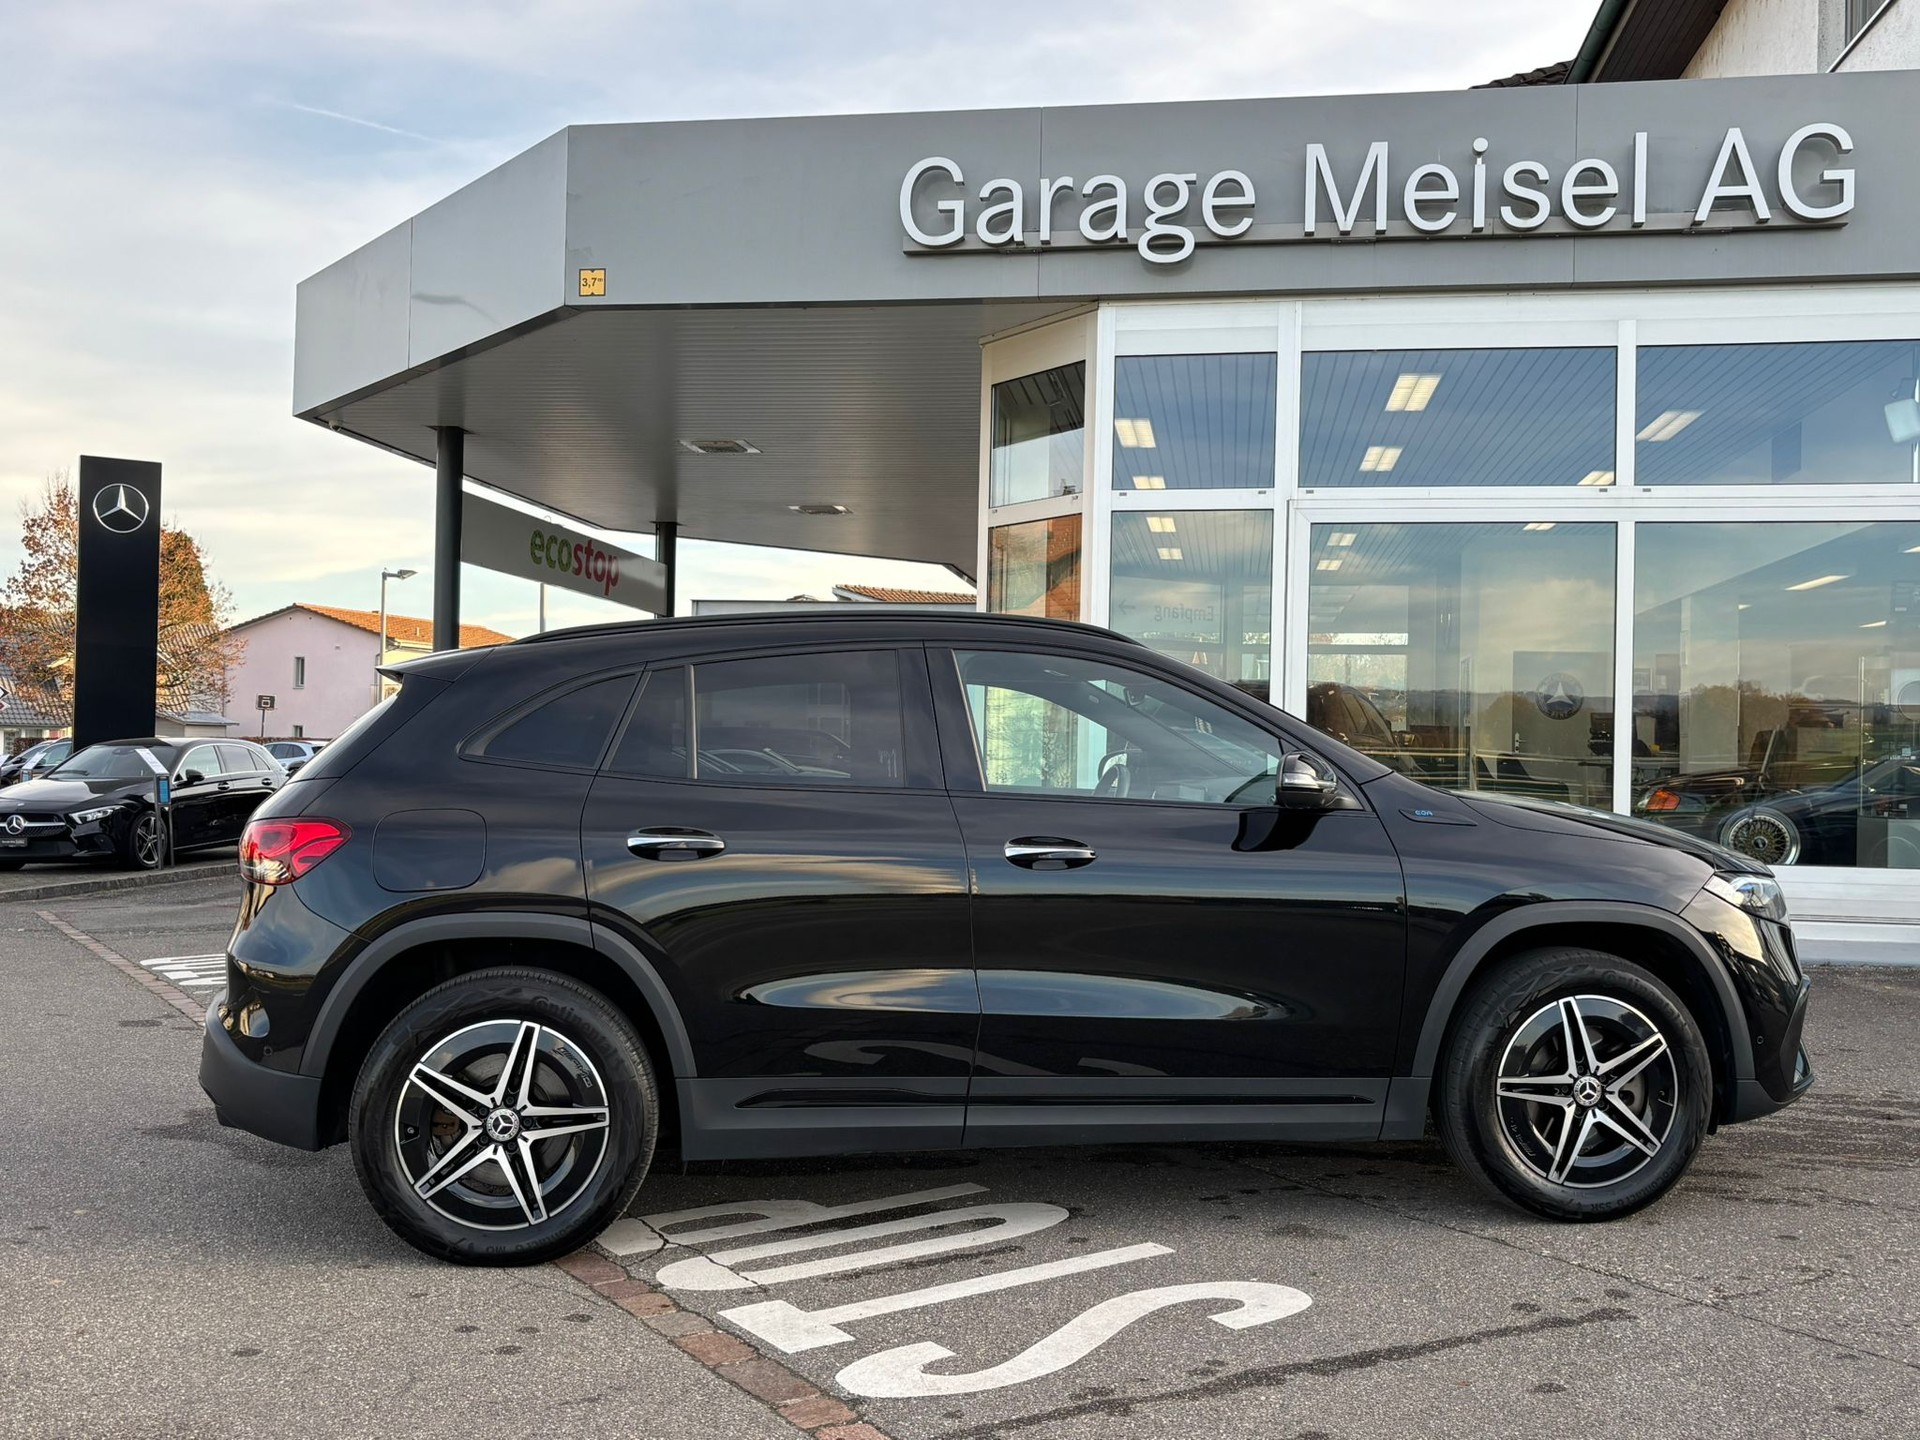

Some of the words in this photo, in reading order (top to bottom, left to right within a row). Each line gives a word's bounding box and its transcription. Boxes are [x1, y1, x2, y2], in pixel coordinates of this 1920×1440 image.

[899, 156, 1256, 265] Garage
[1303, 131, 1648, 236] Meisel
[1691, 122, 1856, 227] AG
[530, 529, 620, 596] ecostop
[597, 1182, 1314, 1399] STOP
